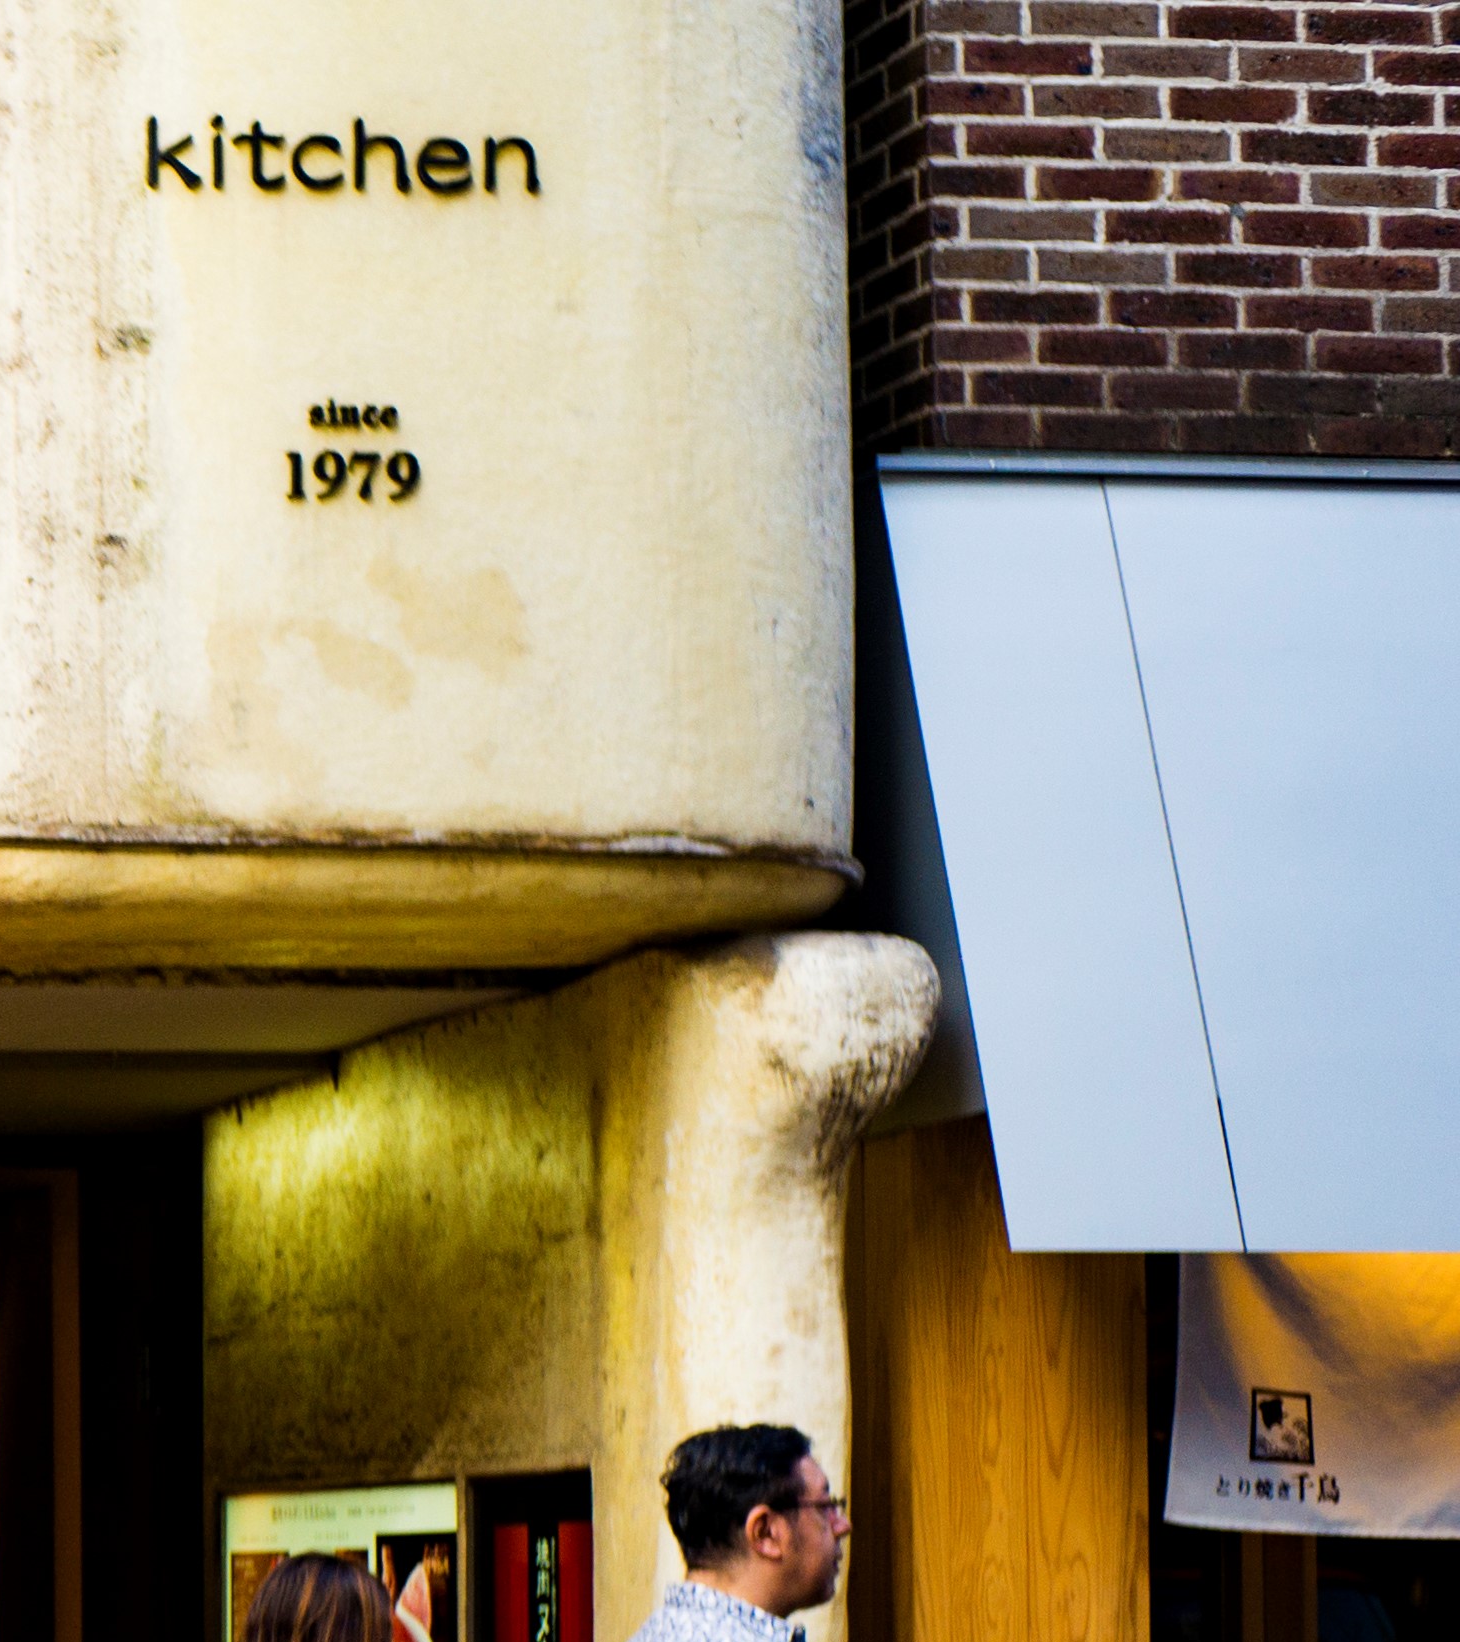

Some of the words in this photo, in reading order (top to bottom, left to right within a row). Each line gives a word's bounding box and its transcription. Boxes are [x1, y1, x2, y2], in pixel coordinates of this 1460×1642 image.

[146, 114, 542, 195] kitchen
[308, 397, 400, 430] since
[285, 450, 421, 502] 1979
